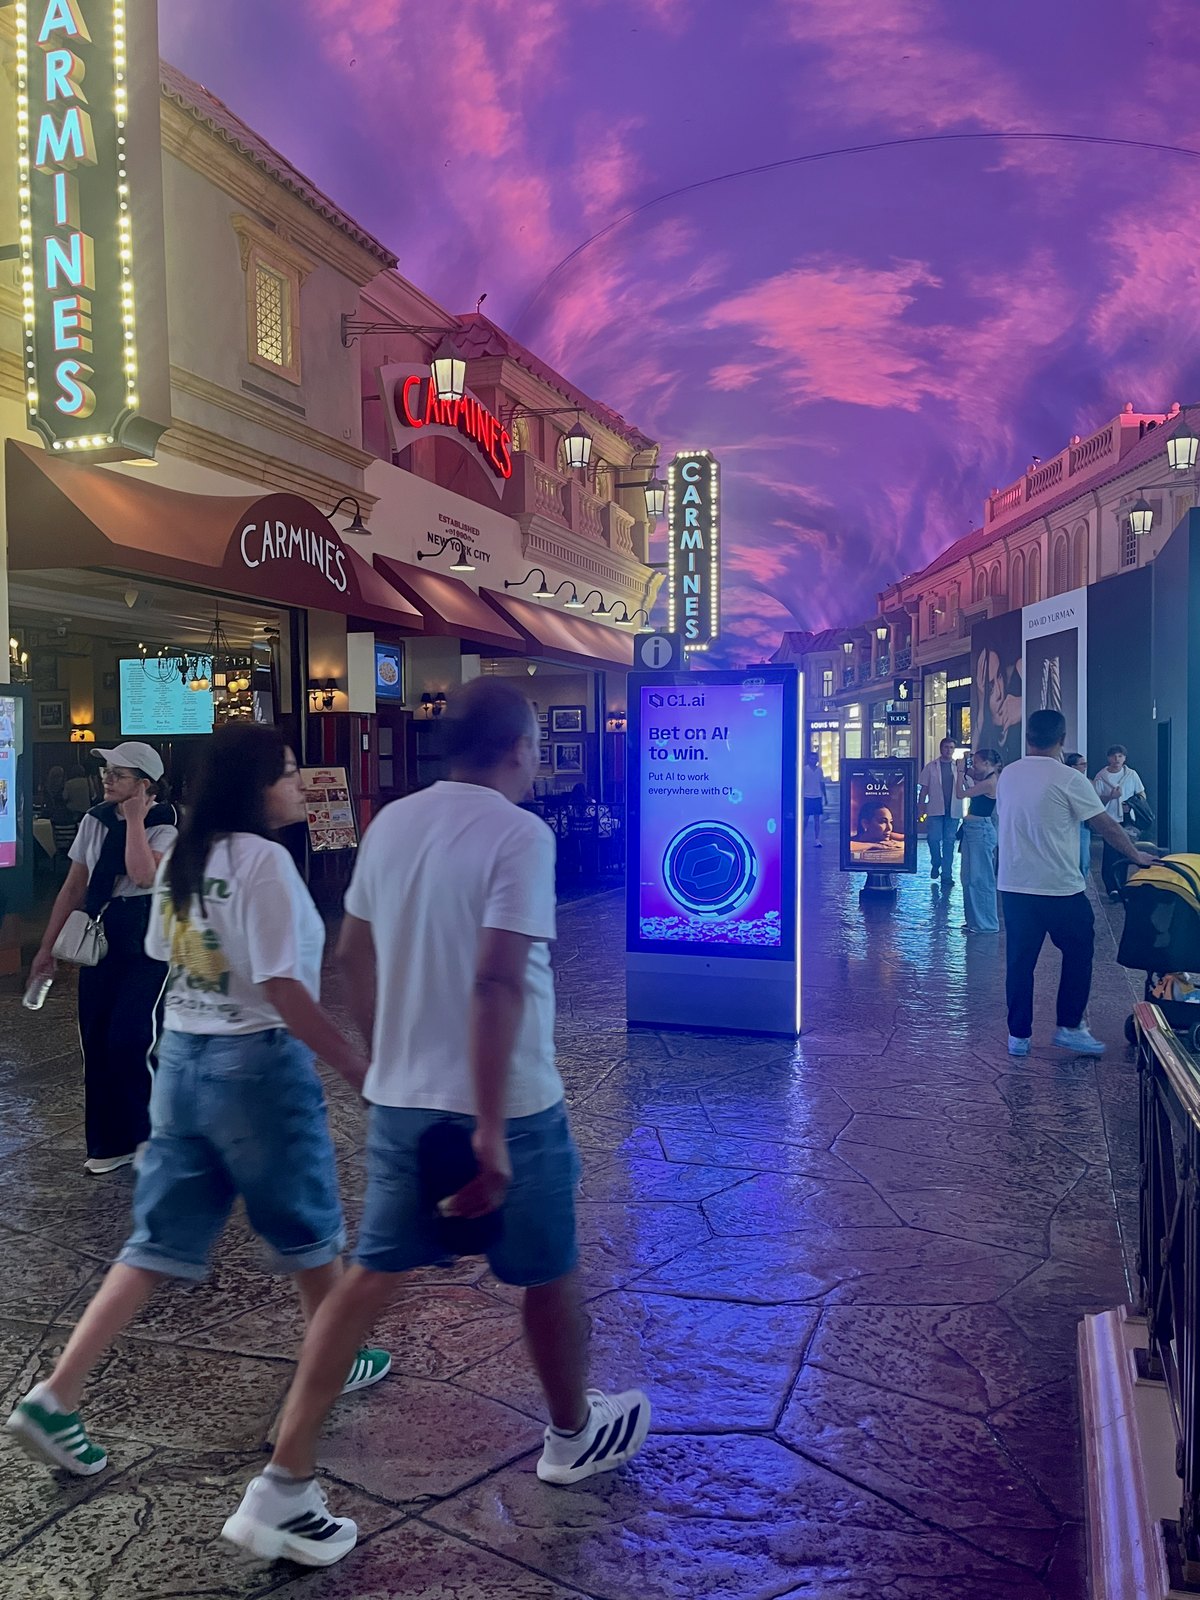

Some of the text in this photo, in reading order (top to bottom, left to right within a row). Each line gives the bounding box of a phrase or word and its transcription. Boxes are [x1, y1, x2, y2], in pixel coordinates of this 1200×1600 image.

[438, 513, 480, 537] ESTABLISHED
[240, 520, 347, 592] CARMINE'S
[473, 549, 490, 563] CITY
[680, 462, 704, 640] CARMINES
[1028, 616, 1047, 628] DAVID
[667, 693, 705, 707] C1.ai
[649, 727, 728, 740] Bet on AI
[649, 745, 709, 760] to win.
[648, 772, 709, 781] Put AI to work
[648, 787, 699, 796] everywhere
[701, 787, 722, 795] with
